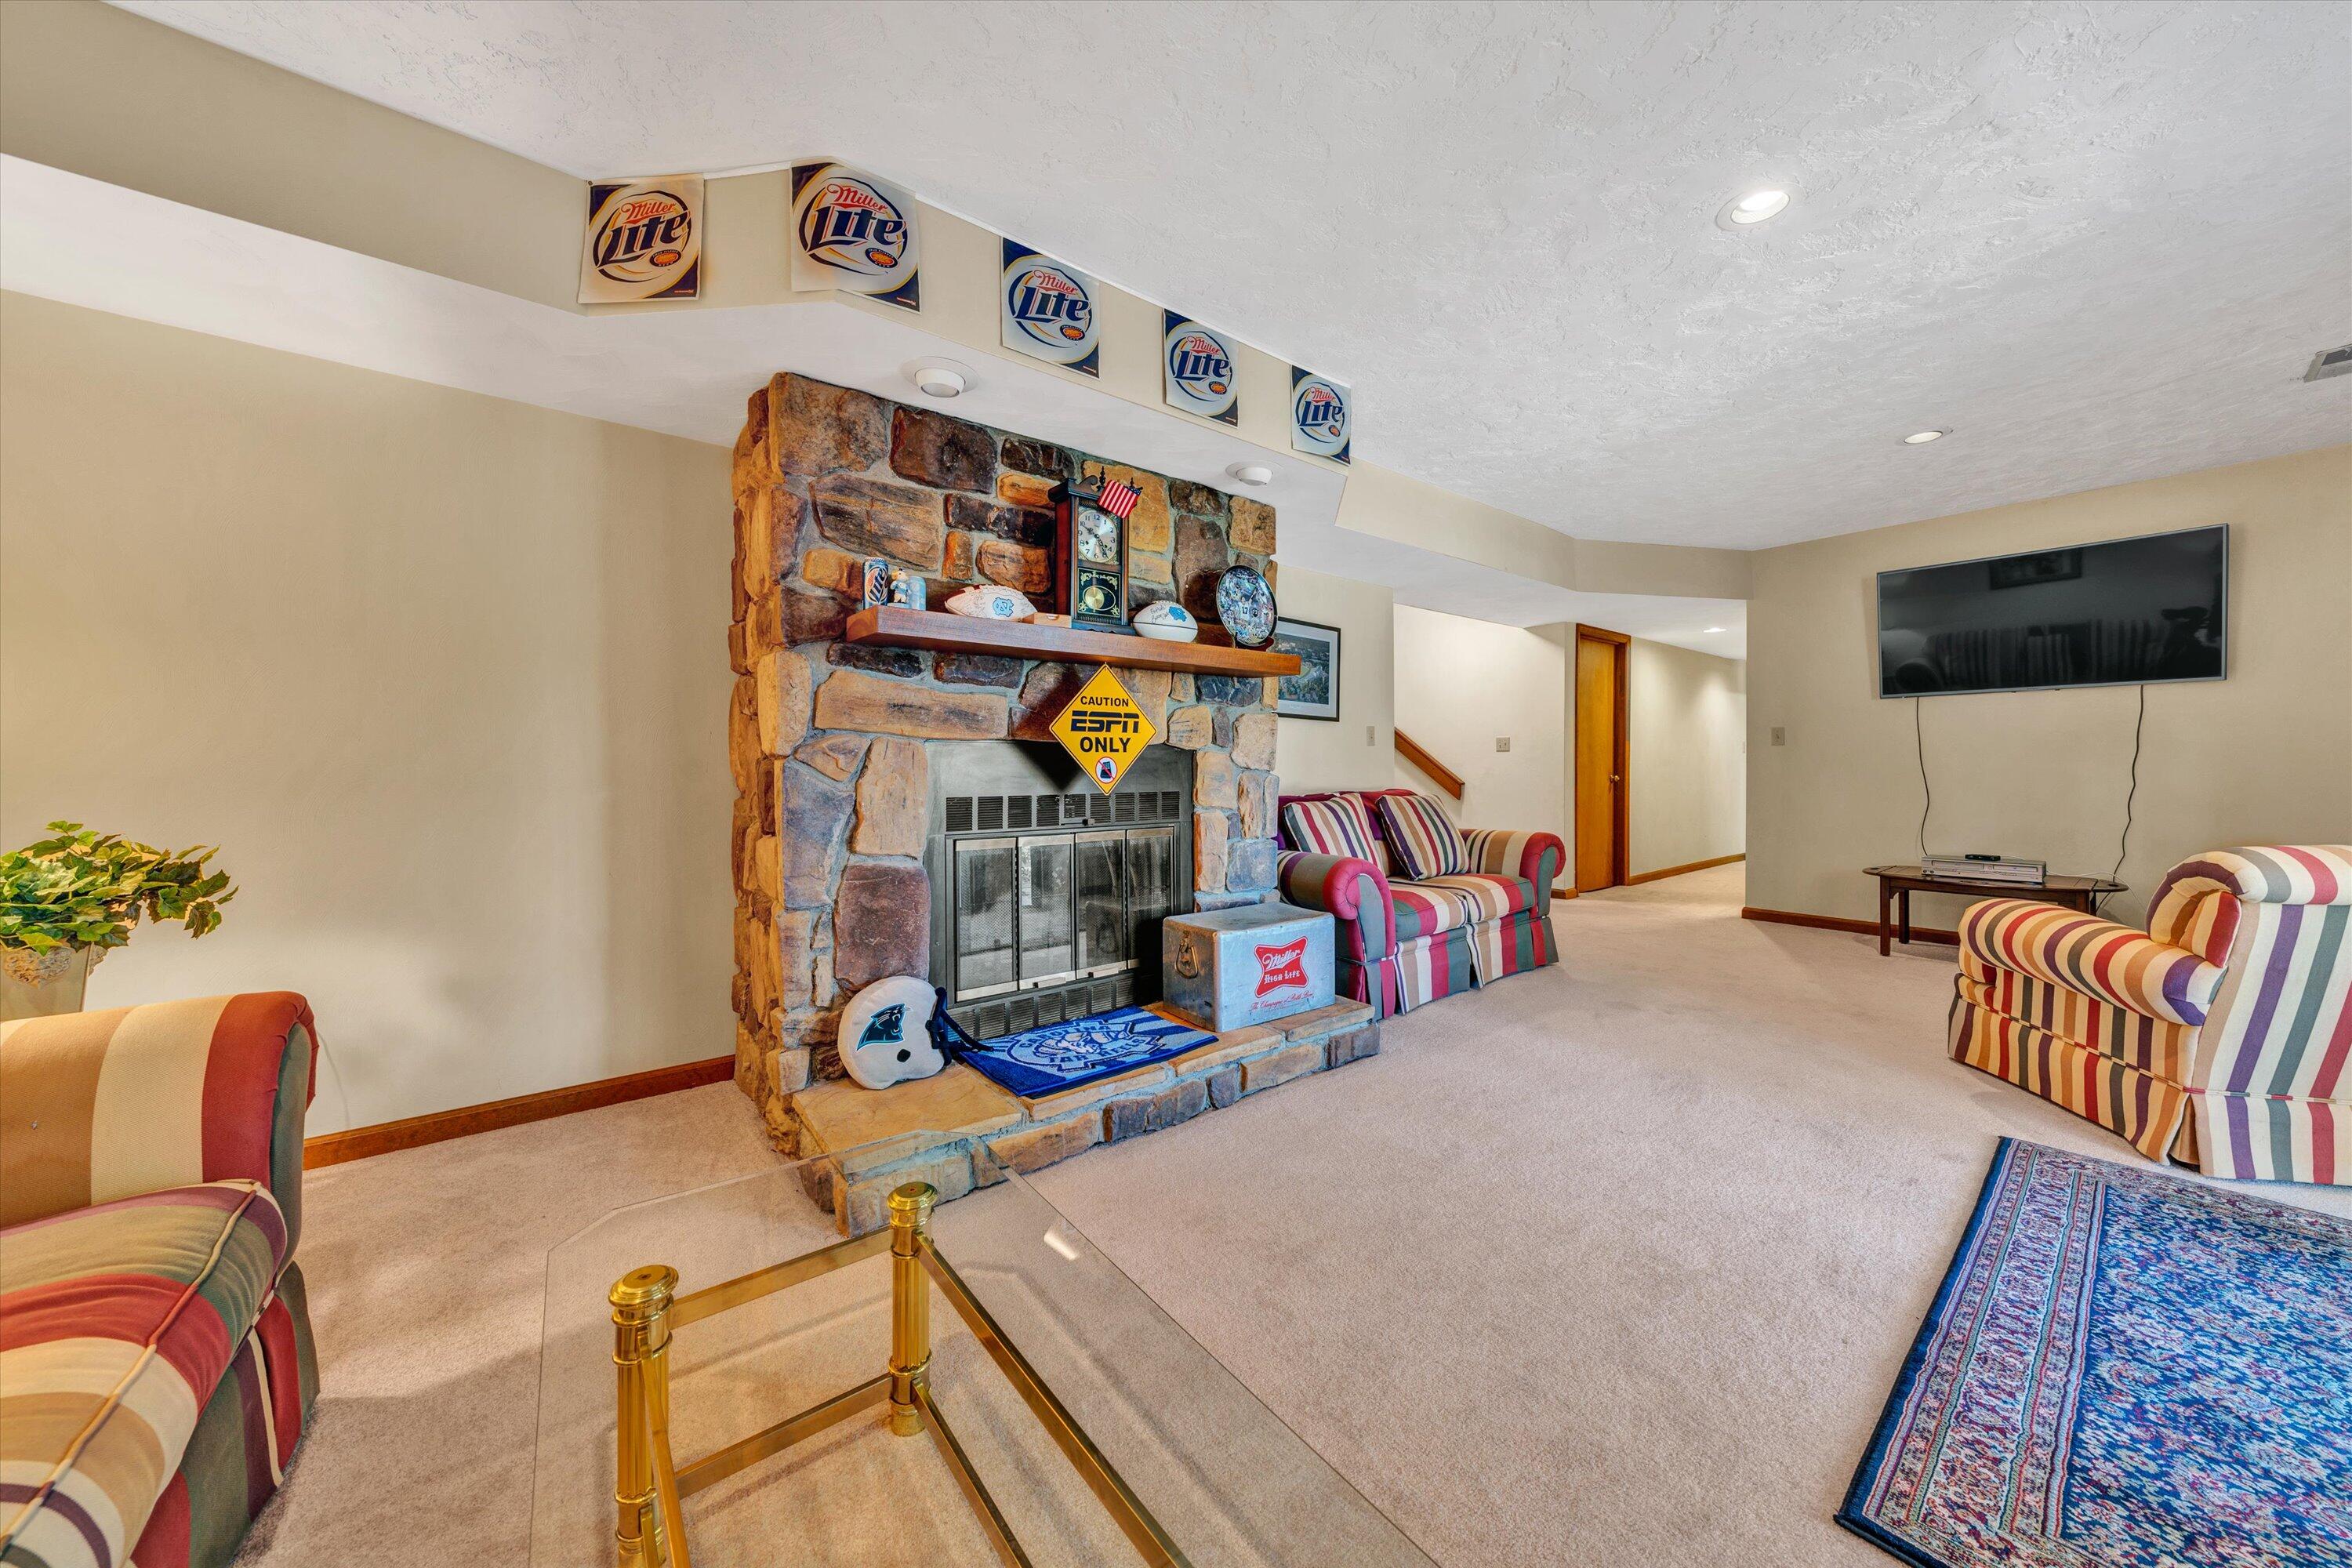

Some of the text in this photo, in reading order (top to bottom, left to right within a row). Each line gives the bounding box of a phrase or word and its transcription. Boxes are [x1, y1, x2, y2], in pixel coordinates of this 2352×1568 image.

[827, 183, 888, 213] Miller
[621, 202, 676, 223] Miller
[597, 211, 690, 268] Lite
[807, 205, 907, 252] Lite
[1033, 270, 1078, 293] Miller
[1013, 285, 1091, 323] Lite
[1187, 336, 1221, 354] Miller
[1174, 350, 1229, 381] Lite
[1298, 401, 1343, 426] Lite
[1080, 696, 1129, 706] CAUTION
[1070, 710, 1140, 734] ESPN
[1080, 736, 1131, 753] ONLY
[1262, 949, 1301, 970] Miller
